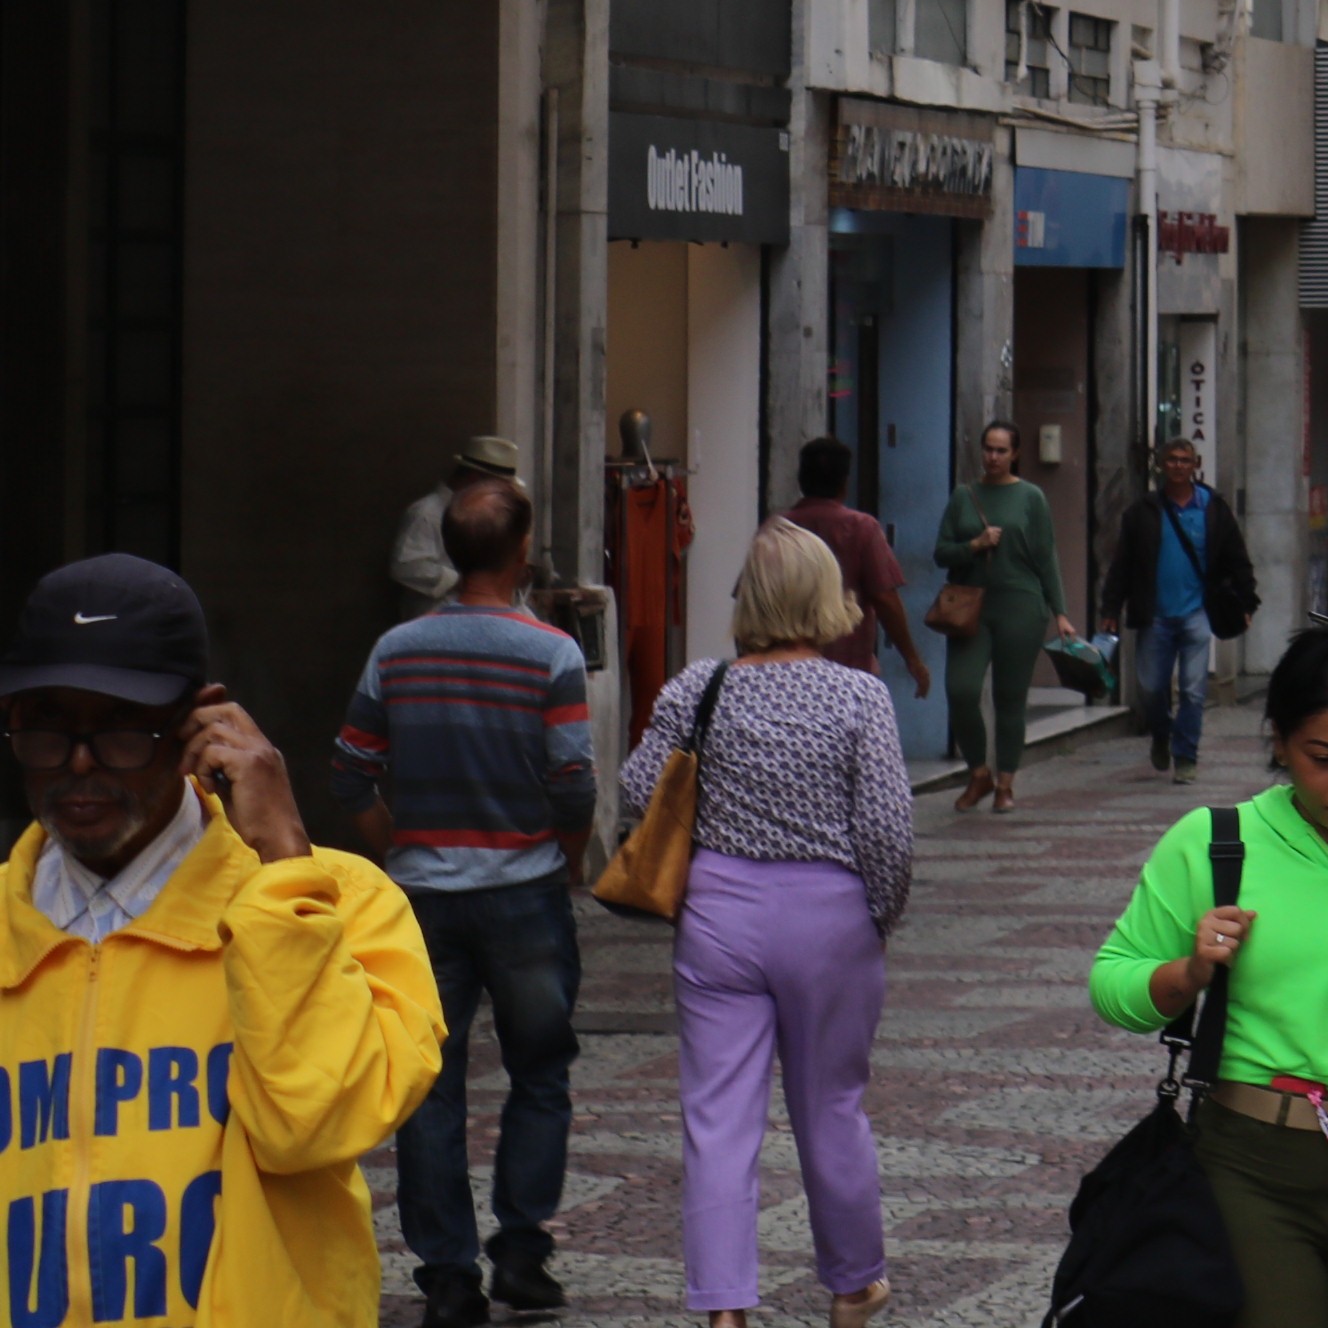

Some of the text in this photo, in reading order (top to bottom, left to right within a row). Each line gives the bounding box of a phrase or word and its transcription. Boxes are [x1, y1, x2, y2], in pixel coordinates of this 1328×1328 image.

[647, 144, 743, 216] Outlet Fashion
[1190, 360, 1206, 441] ÓTICA
